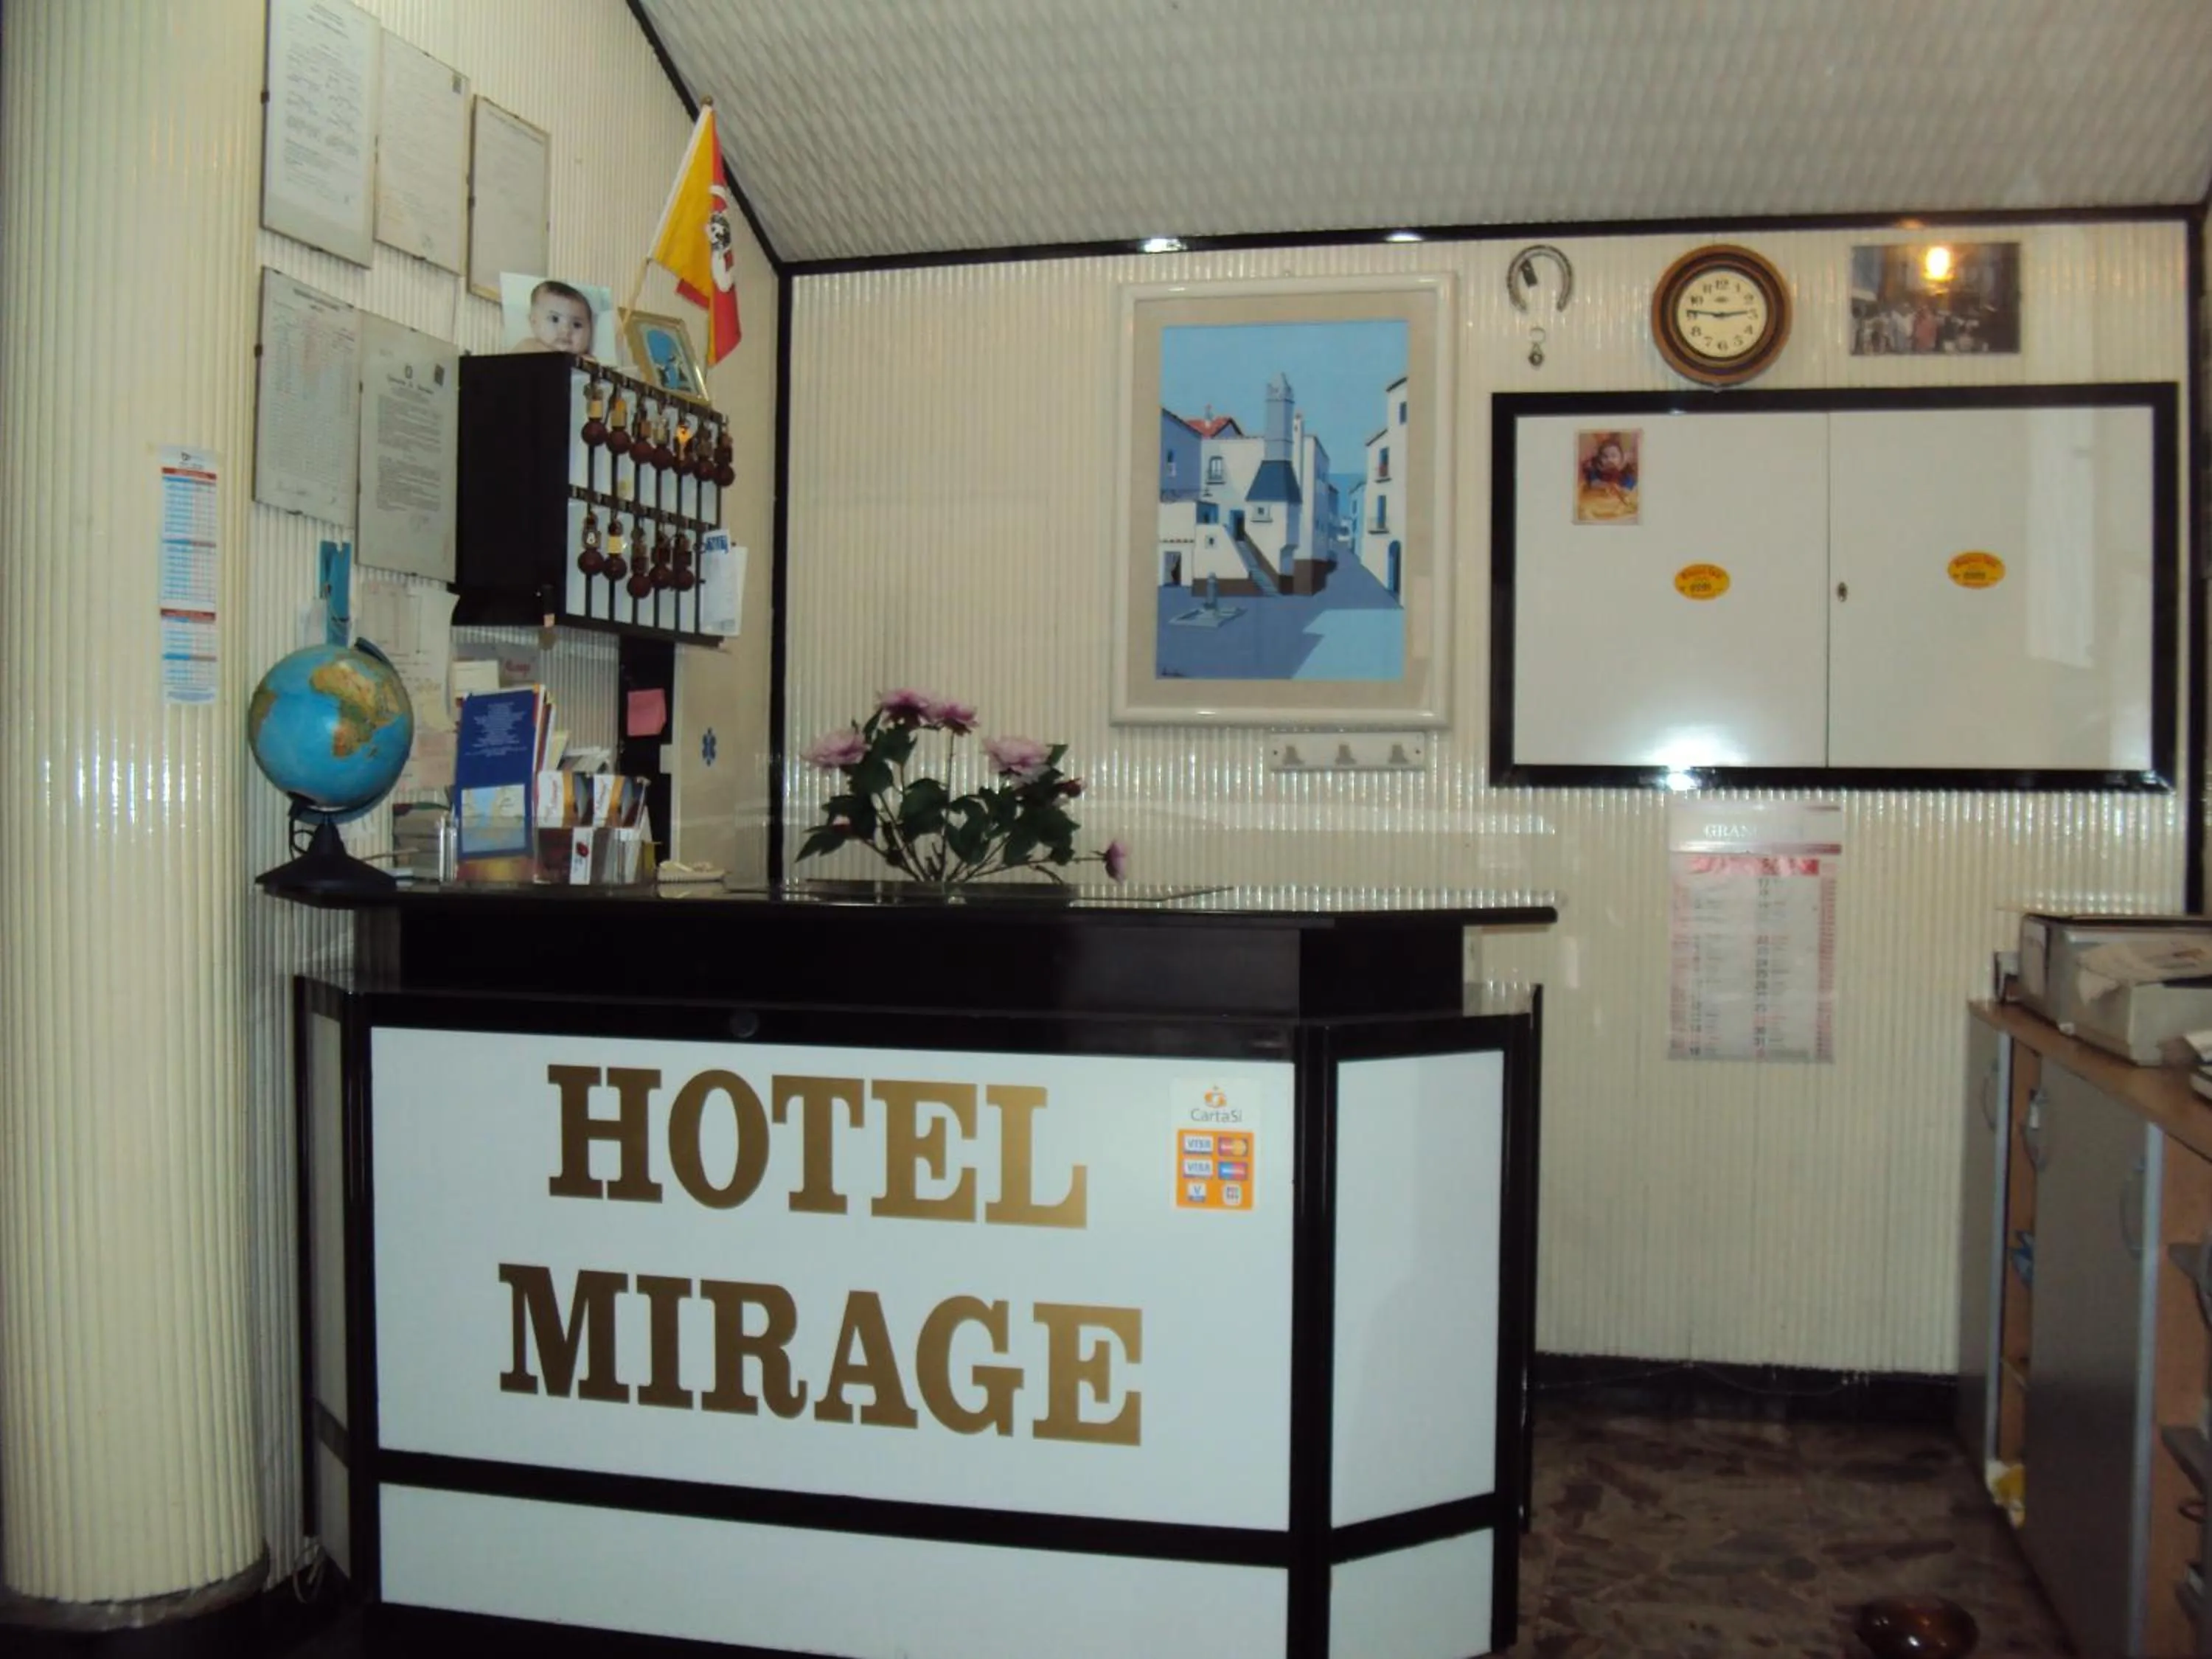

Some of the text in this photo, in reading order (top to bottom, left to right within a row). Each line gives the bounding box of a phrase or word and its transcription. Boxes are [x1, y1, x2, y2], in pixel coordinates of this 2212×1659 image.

[1714, 279, 1729, 291] 12
[1691, 295, 1703, 305] 10
[1691, 326, 1702, 336] 8
[1744, 324, 1753, 335] 4
[1704, 337, 1714, 347] 7
[1717, 341, 1728, 351] 6
[1733, 337, 1744, 347] 5
[547, 1064, 1088, 1230] HOTEL
[498, 1262, 1142, 1447] MIRAGE
